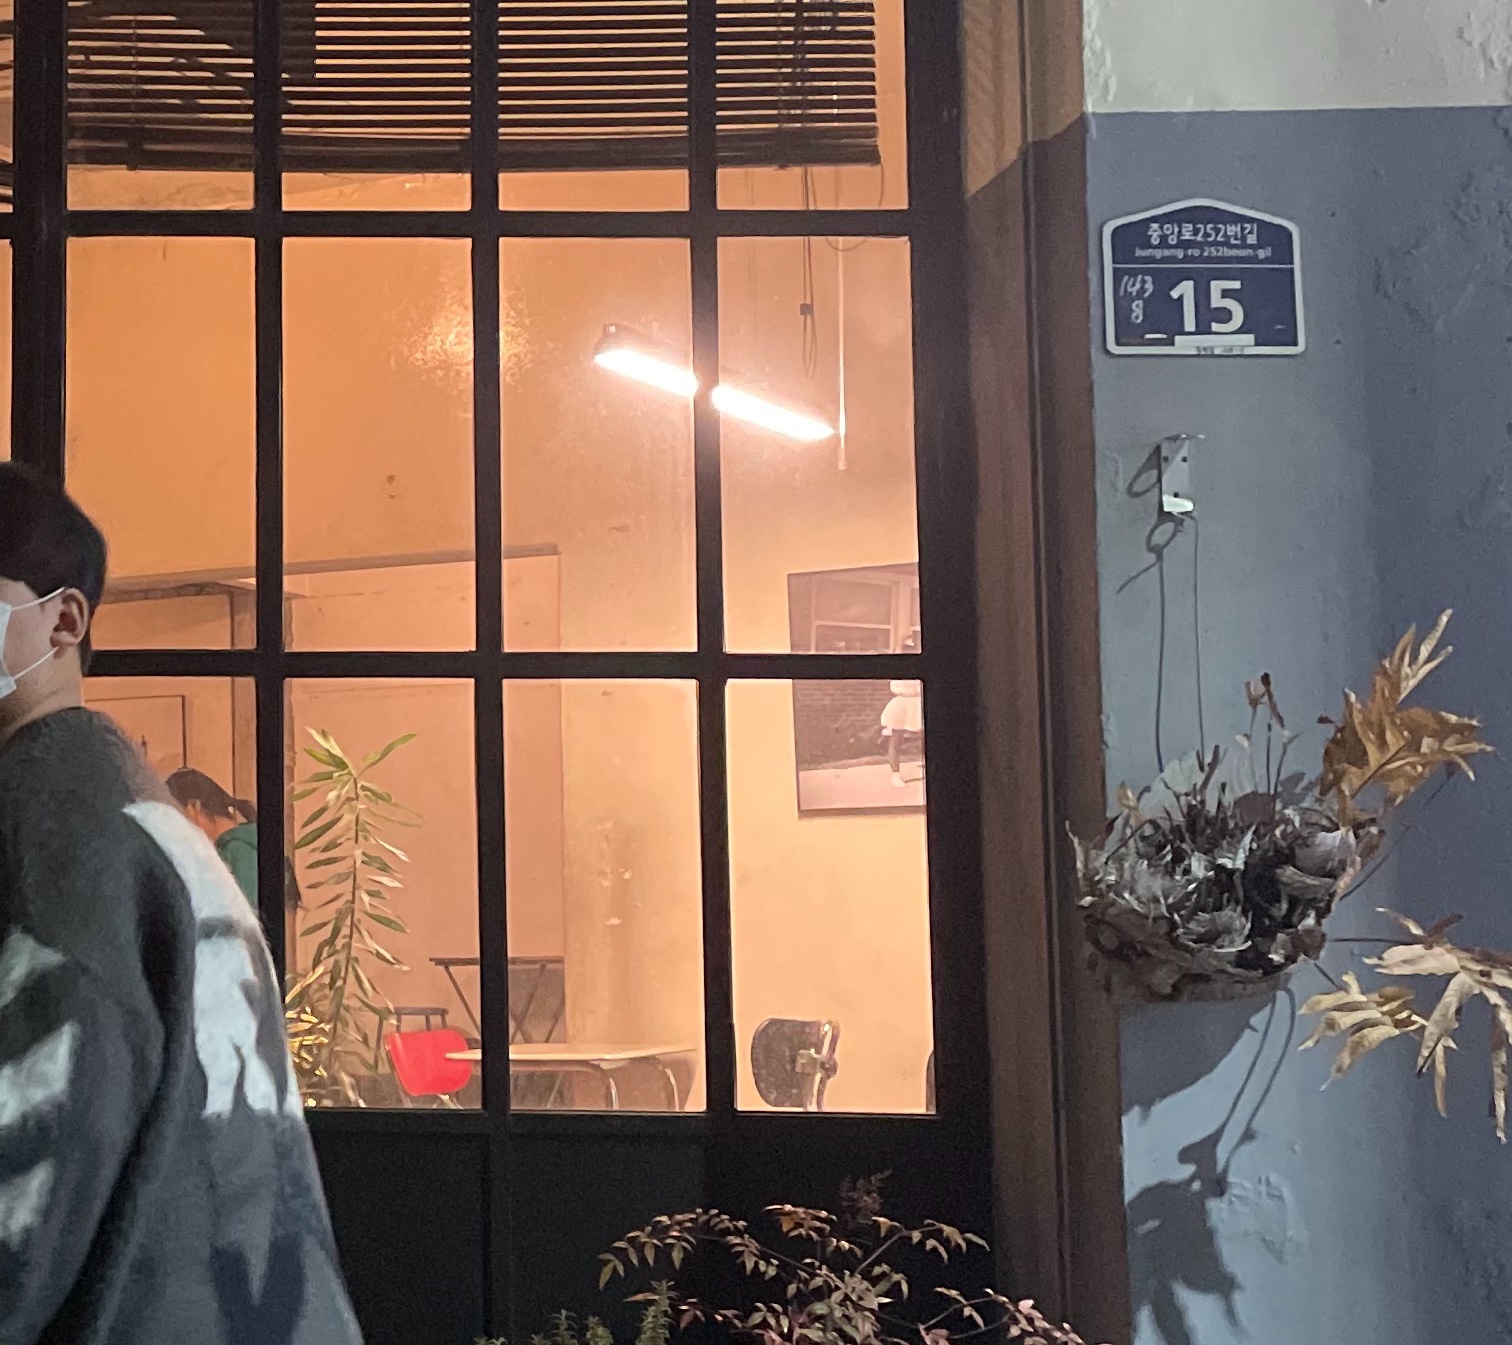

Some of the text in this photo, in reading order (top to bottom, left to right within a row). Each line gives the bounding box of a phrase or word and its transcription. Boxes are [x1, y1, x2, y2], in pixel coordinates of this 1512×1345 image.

[1147, 222, 1258, 245] 중앙로252번길
[1119, 274, 1154, 298] 143
[1130, 299, 1144, 324] 8
[1169, 279, 1245, 333] 15
